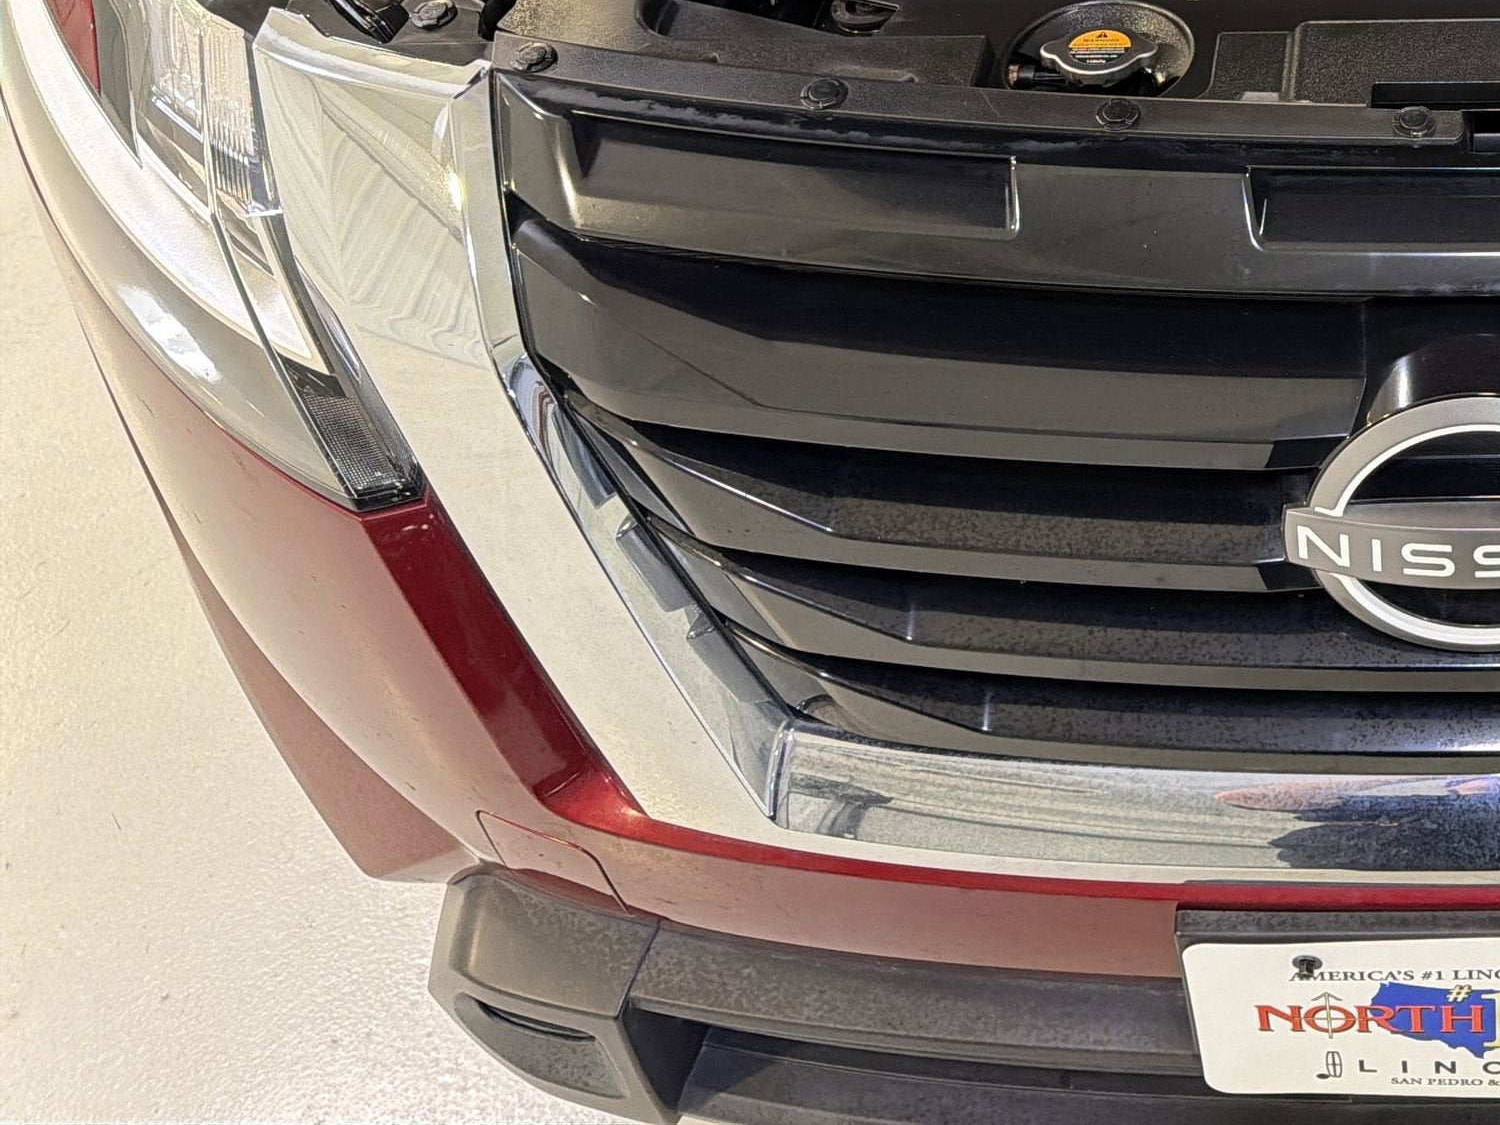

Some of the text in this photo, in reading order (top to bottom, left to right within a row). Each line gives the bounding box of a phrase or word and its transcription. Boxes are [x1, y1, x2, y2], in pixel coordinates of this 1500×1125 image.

[1421, 969, 1444, 981] #1
[1254, 1004, 1486, 1034] NORTH
[1391, 1077, 1423, 1085] SAN
[1427, 1078, 1484, 1086] PEDRO
